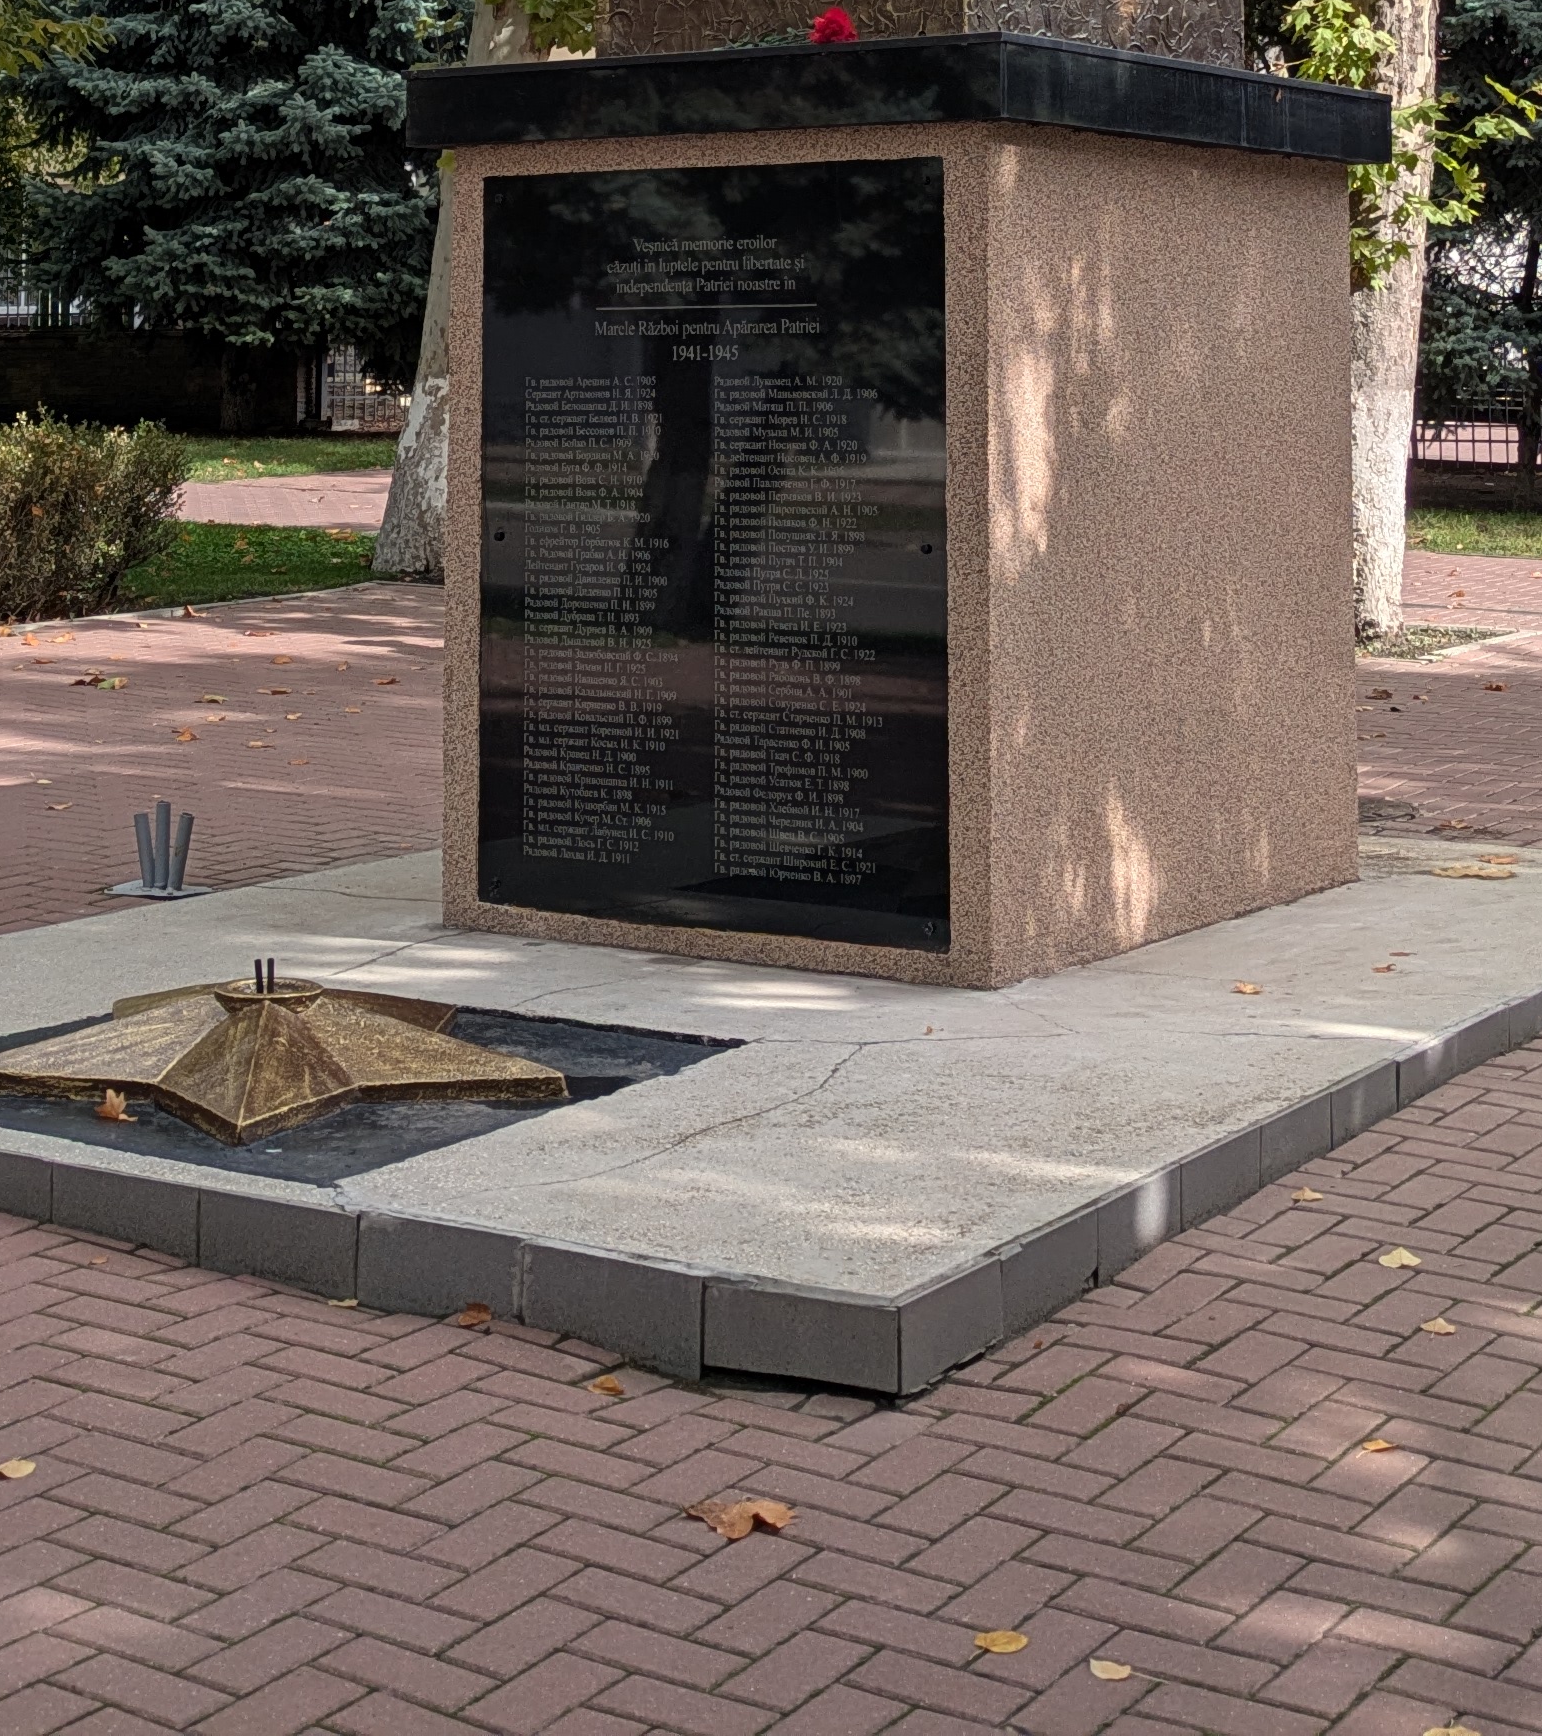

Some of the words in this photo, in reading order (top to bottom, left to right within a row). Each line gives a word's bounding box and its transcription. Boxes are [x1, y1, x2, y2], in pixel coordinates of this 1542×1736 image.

[681, 236, 733, 251] memorie
[736, 234, 777, 250] eroilor
[658, 258, 699, 276] luptele
[701, 259, 739, 275] pentru
[742, 255, 792, 270] libertate
[696, 276, 734, 292] Patriei
[737, 279, 781, 292] noastre
[594, 321, 636, 336] Marele
[638, 320, 679, 336] Război
[682, 321, 720, 339] pentru
[722, 318, 777, 338] Apărarea
[780, 317, 820, 334] Patriei
[672, 344, 739, 361] 1941-1945
[714, 376, 750, 387] Рядовой
[822, 376, 843, 386] 1920
[636, 388, 656, 398] 1924
[729, 389, 765, 401] рядовой
[856, 388, 878, 399] 1906
[714, 401, 750, 412] Рядовой
[812, 401, 834, 411] 1906
[826, 414, 847, 424] 1918
[714, 426, 750, 438] Рядовой
[818, 427, 839, 437] 1905
[836, 440, 858, 450] 1920
[845, 453, 867, 463] 1919
[649, 537, 669, 548] 1916
[632, 562, 651, 573] 1924
[714, 579, 750, 591] Рядовой
[809, 581, 830, 592] 1923
[729, 632, 766, 643] рядовой
[837, 635, 858, 646] 1910
[854, 649, 876, 660] 1922
[645, 740, 666, 751] 1910
[714, 733, 750, 745] Рядовой
[829, 739, 850, 751] 1905
[523, 758, 557, 770] Рядовой
[630, 763, 651, 775] 1895
[729, 762, 766, 772] рядовой
[847, 767, 869, 779] 1900
[729, 775, 766, 785] рядовой
[828, 779, 850, 791] 1898
[523, 783, 557, 795] Рядовой
[613, 788, 633, 800] 1898
[729, 801, 766, 812] рядовой
[838, 807, 860, 818] 1917
[537, 811, 572, 822] рядовой
[631, 815, 652, 827] 1906
[855, 861, 876, 873] 1921
[729, 866, 766, 877] рядовой
[840, 873, 862, 885] 1897
